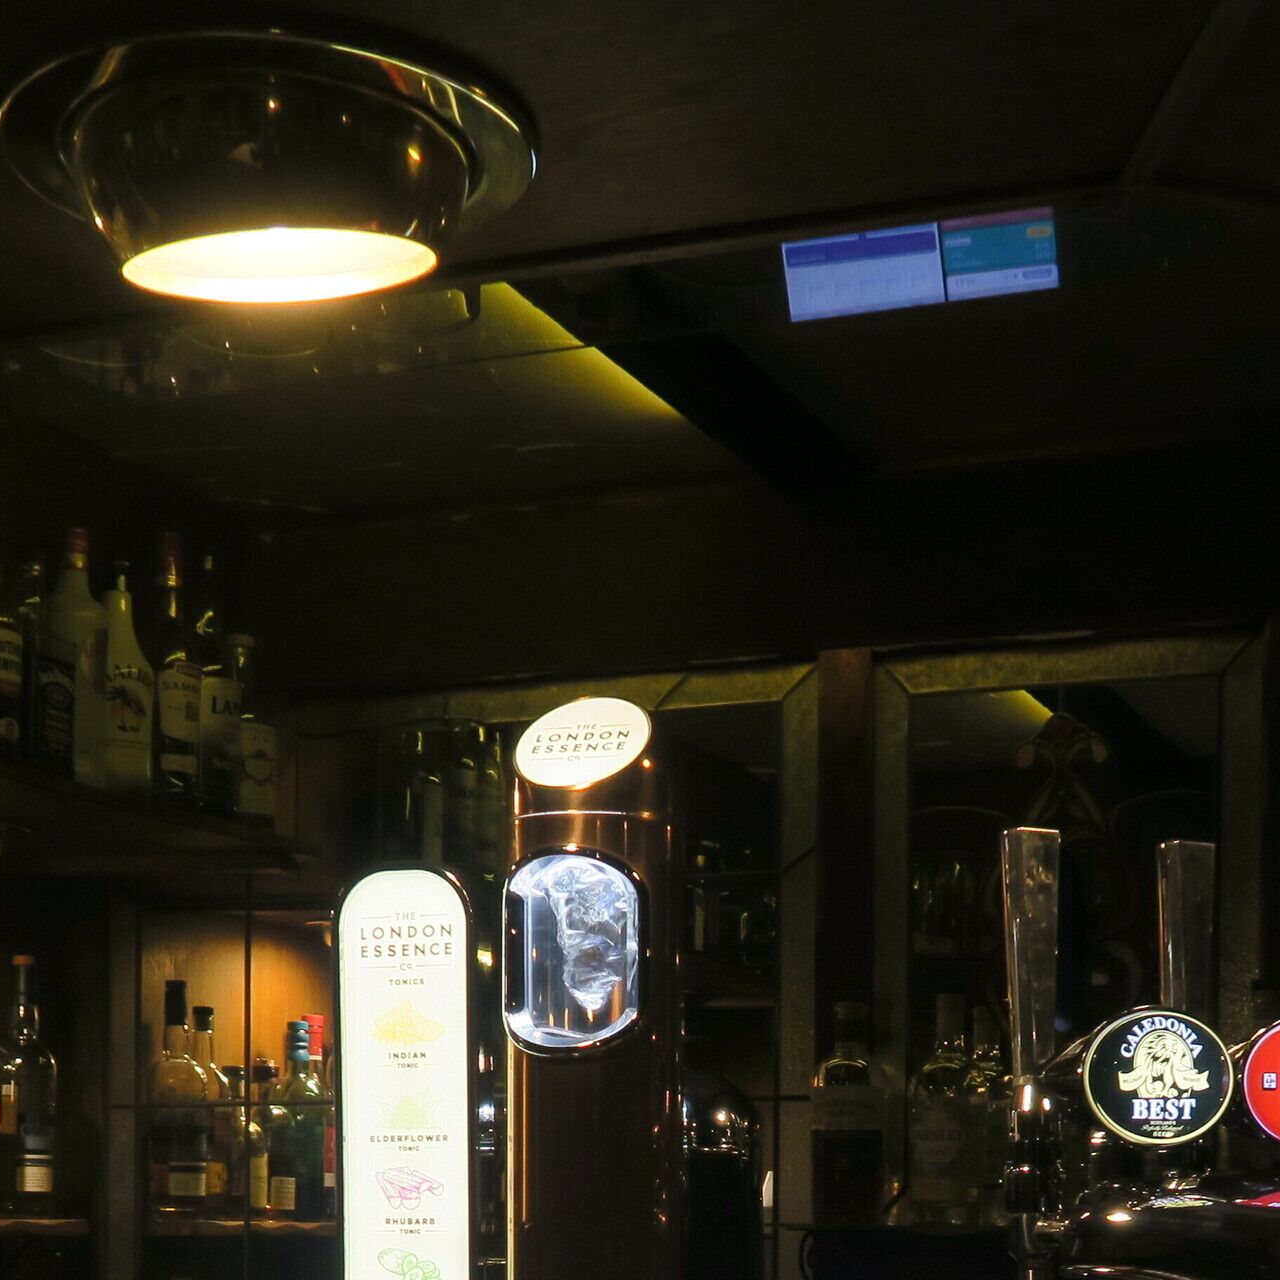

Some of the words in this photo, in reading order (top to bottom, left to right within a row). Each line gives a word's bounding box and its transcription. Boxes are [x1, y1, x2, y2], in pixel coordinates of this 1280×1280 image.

[536, 730, 631, 743] LONDON
[531, 741, 627, 754] ESSENCE
[395, 911, 417, 921] THE
[360, 923, 453, 940] LONDON
[360, 942, 454, 958] ESSENCE
[389, 978, 425, 986] TONICS
[1120, 1016, 1204, 1058] CALEDONIA
[388, 1051, 427, 1060] INDIAN
[1131, 1098, 1197, 1120] BEST
[370, 1134, 449, 1143] ELDERFLOWER
[385, 1217, 435, 1226] RHUBARB
